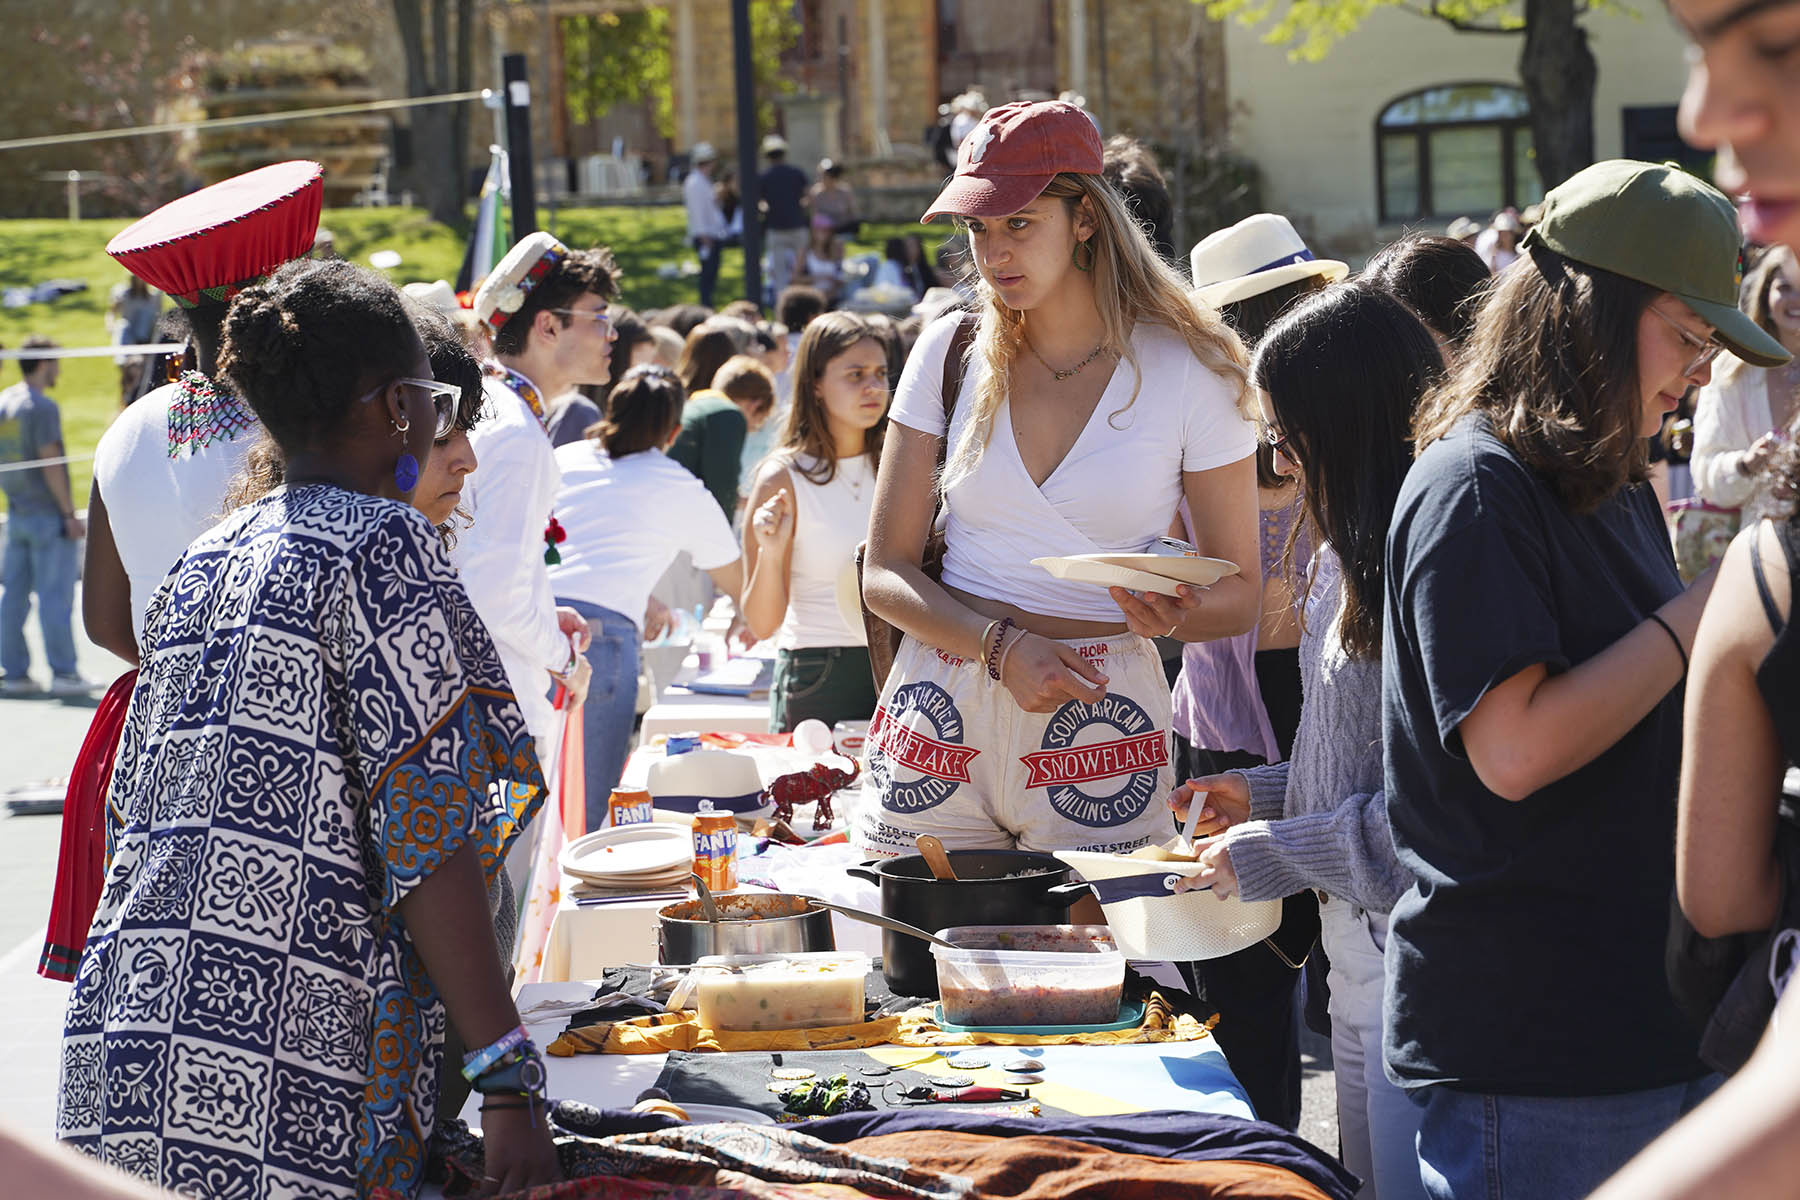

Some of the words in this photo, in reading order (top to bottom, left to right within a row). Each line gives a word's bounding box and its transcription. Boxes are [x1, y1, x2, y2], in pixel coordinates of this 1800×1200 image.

[1049, 700, 1089, 745] SOUTH
[1039, 738, 1160, 780] SNOWFLAKE
[614, 802, 653, 825] FANT
[1053, 787, 1111, 822] MILLING
[878, 822, 921, 839] STREE
[1109, 835, 1151, 852] STREET
